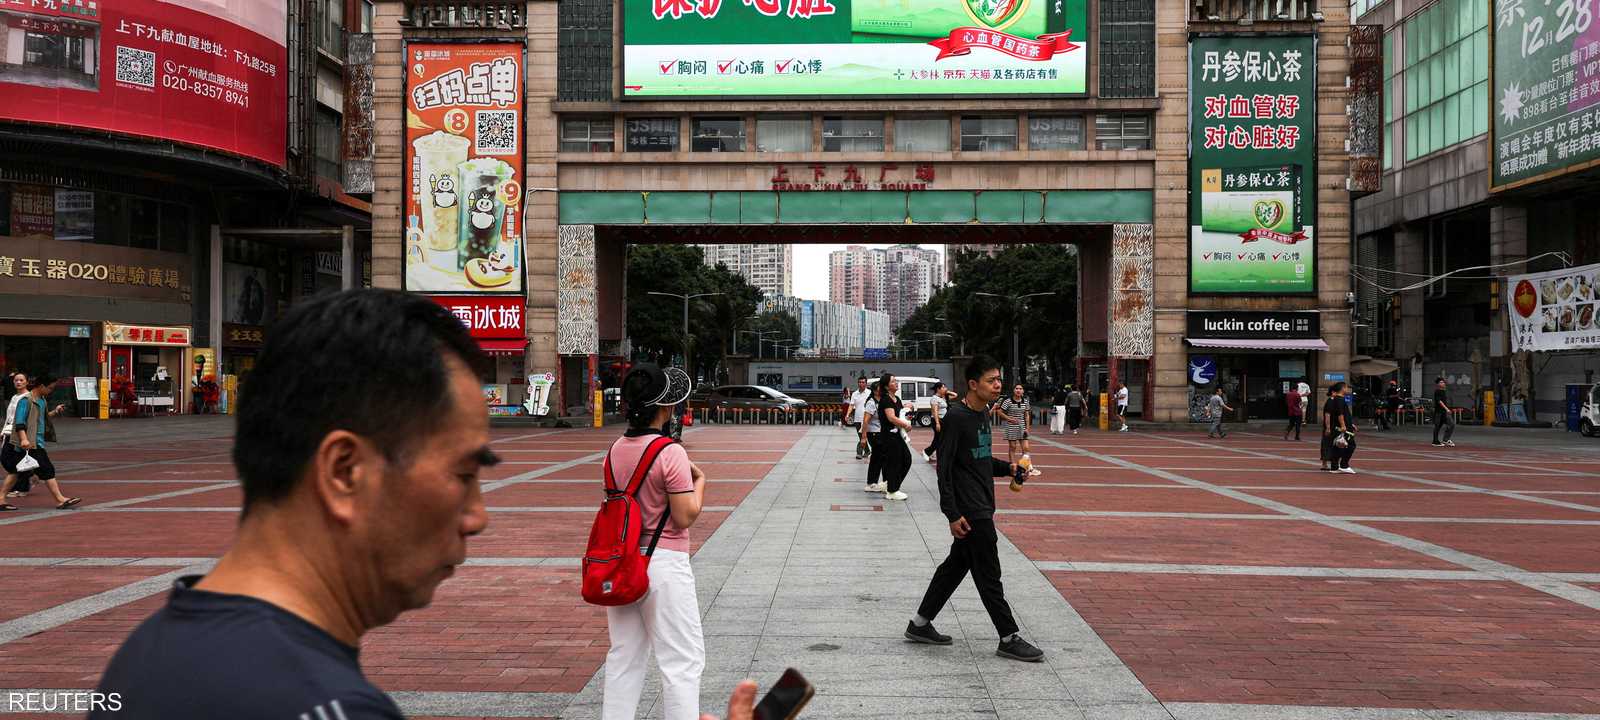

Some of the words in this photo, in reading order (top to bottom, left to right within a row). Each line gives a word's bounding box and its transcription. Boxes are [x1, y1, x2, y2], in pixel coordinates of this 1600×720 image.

[963, 32, 1041, 57] 心血管国药茶
[677, 60, 707, 75] 胸闷
[734, 60, 765, 75] 心痛
[792, 59, 823, 75] 心悸
[943, 70, 966, 80] 京东
[1202, 50, 1302, 82] 丹参保心茶
[177, 64, 248, 93] 广州献血服务热线
[412, 57, 518, 110] 扫码点单
[162, 74, 223, 101] 020-8357
[225, 92, 248, 109] 8941
[1204, 94, 1300, 119] 对血管好
[450, 112, 466, 132] 8
[1204, 124, 1300, 149] 对心脏好
[1224, 171, 1290, 188] 丹参保心茶
[504, 182, 521, 205] 9
[1213, 252, 1232, 261] 胸闷
[1248, 252, 1266, 261] 心痛
[1205, 318, 1244, 331] luckin
[1248, 318, 1290, 331] coffee
